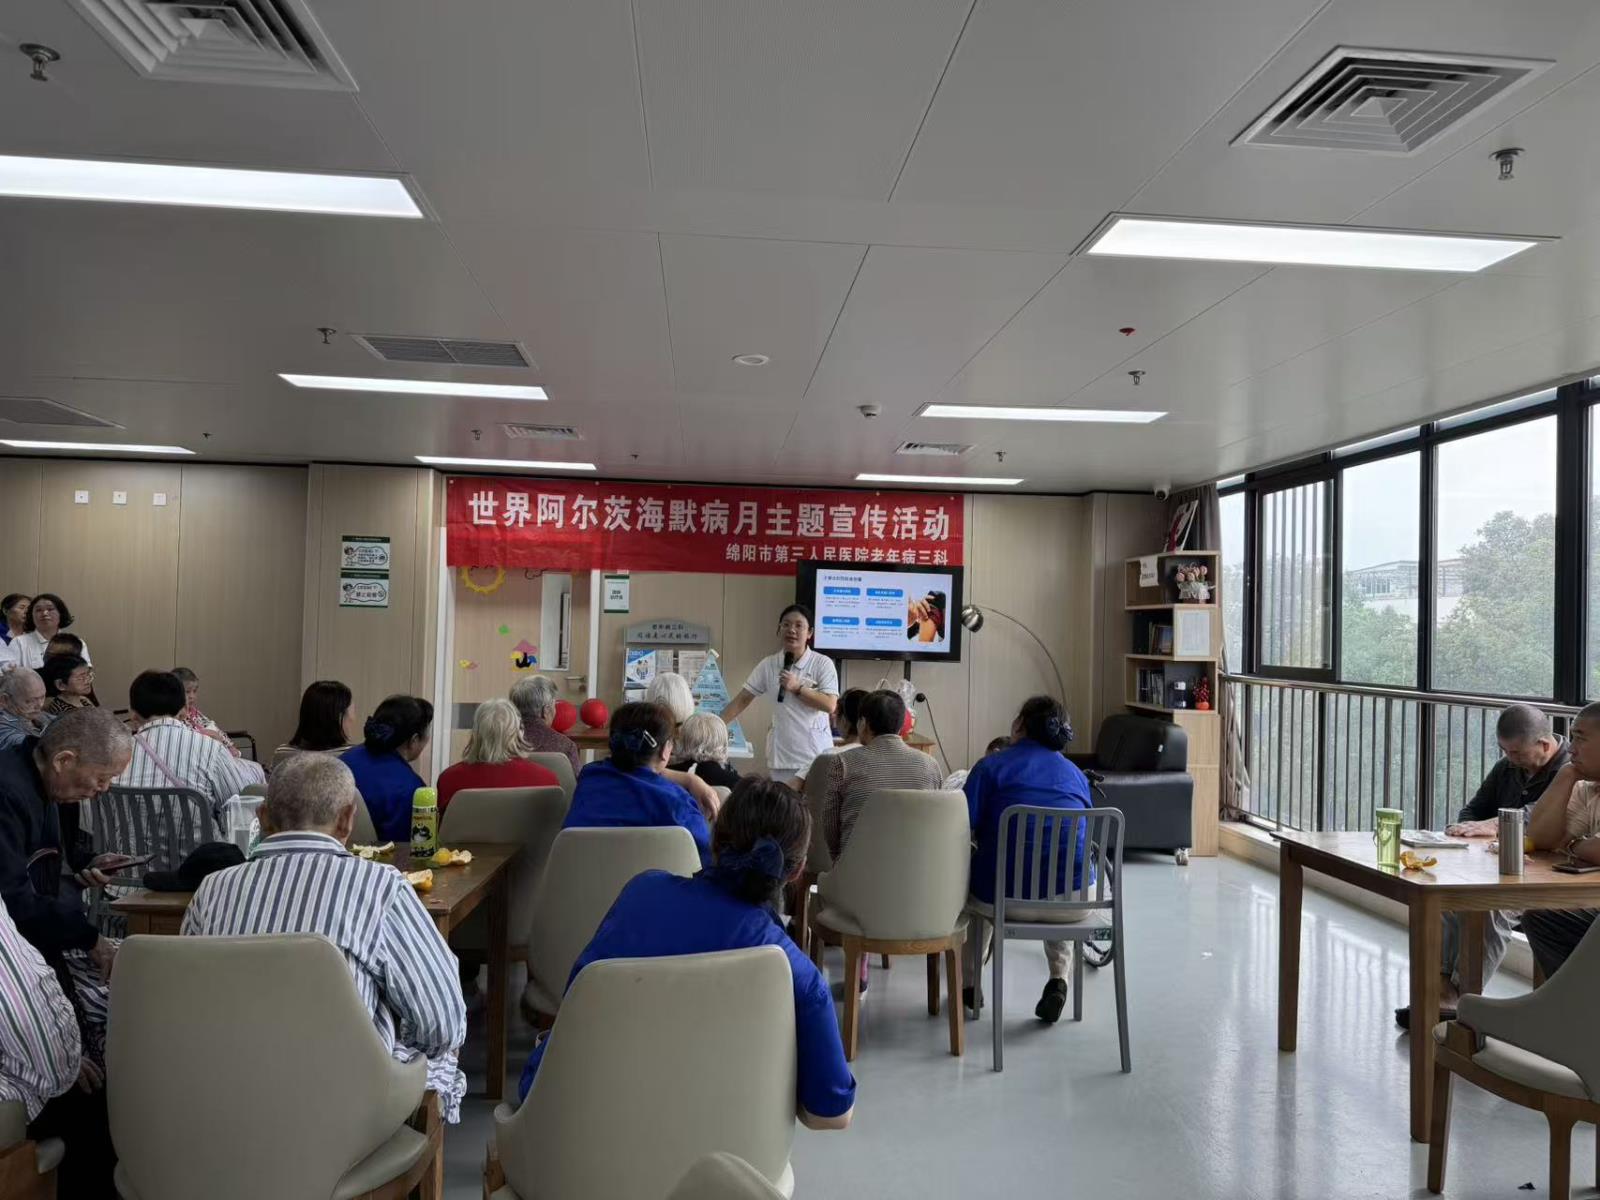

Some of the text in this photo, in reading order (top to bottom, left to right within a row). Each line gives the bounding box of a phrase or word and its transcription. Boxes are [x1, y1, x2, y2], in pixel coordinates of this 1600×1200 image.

[468, 491, 950, 541] 世界阿尔茨海默病月主题宣传活动
[725, 543, 949, 566] 绵阳市第三人民医院老年病三科
